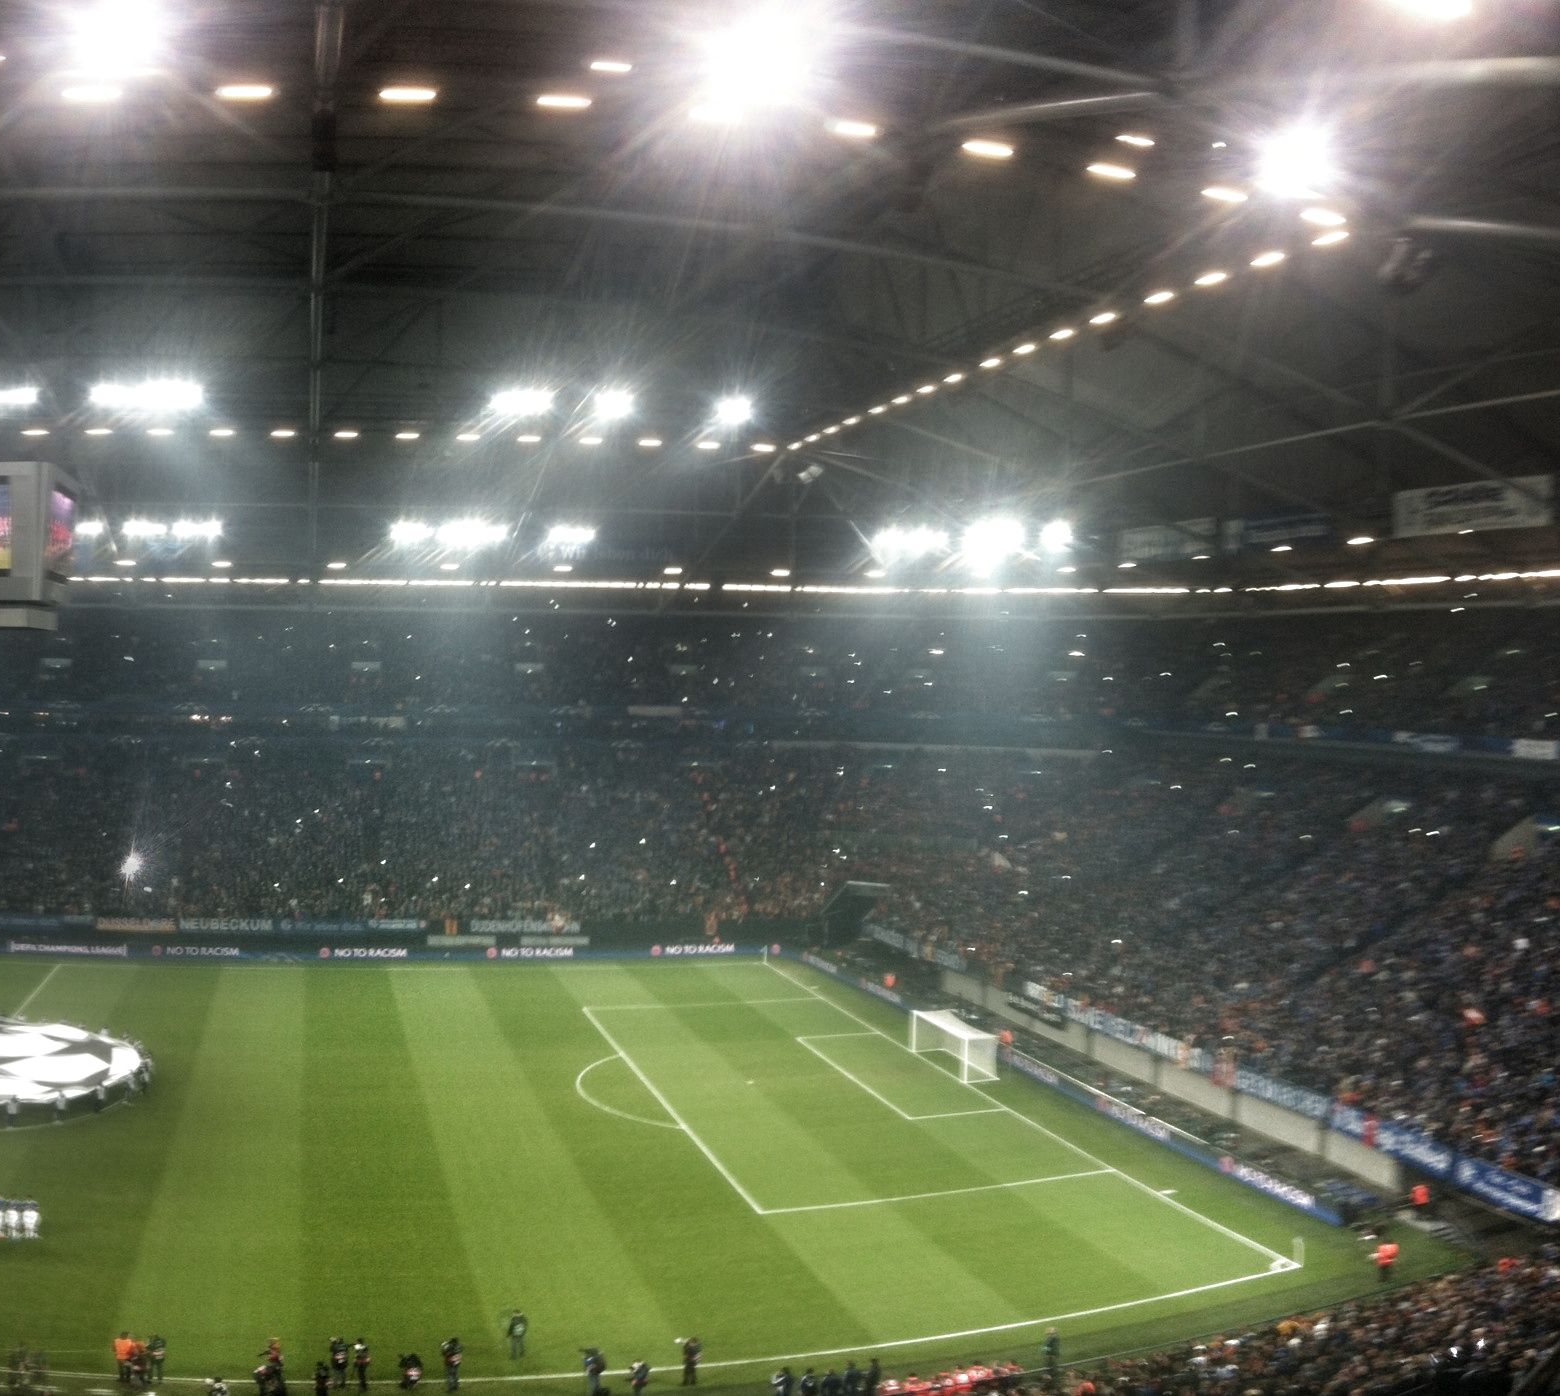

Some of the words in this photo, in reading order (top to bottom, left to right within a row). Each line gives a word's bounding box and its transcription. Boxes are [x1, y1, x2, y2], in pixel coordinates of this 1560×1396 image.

[179, 918, 273, 931] NEUBECKUM
[166, 946, 183, 956] NO
[184, 946, 199, 956] TO
[200, 946, 240, 956] RACISM
[334, 948, 351, 957] NO
[352, 948, 367, 957] TO
[368, 948, 408, 957] RACISM
[501, 946, 518, 957] NO
[519, 947, 534, 957] TO
[535, 947, 574, 957] RACISM
[665, 946, 682, 955] NO
[683, 945, 697, 955] TO
[698, 943, 735, 954] RACISM
